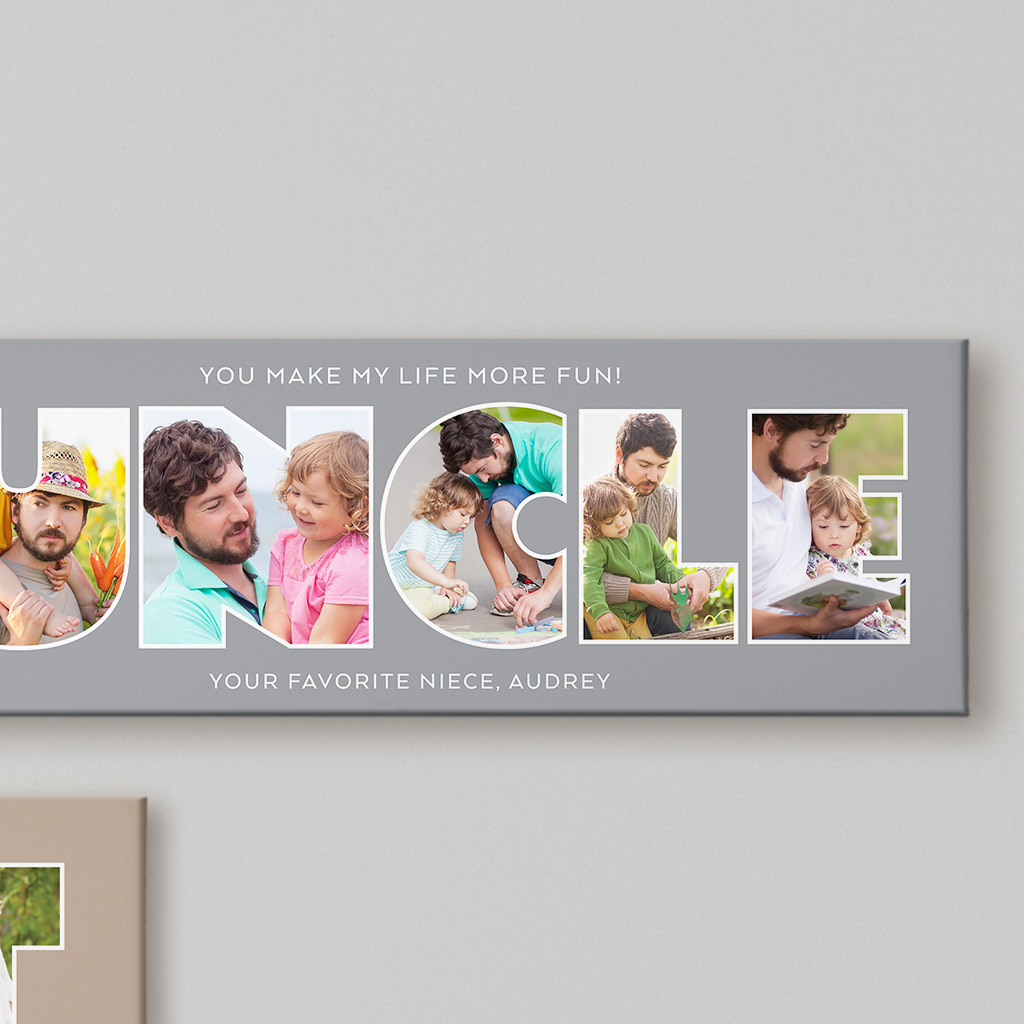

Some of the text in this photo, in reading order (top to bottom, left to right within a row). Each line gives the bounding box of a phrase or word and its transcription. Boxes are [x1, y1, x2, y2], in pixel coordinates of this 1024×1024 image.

[199, 366, 621, 385] YOU MAKE MY LIFE MORE FUN!
[209, 672, 611, 693] YOUR FAVORITE NIECE, AUDREY
